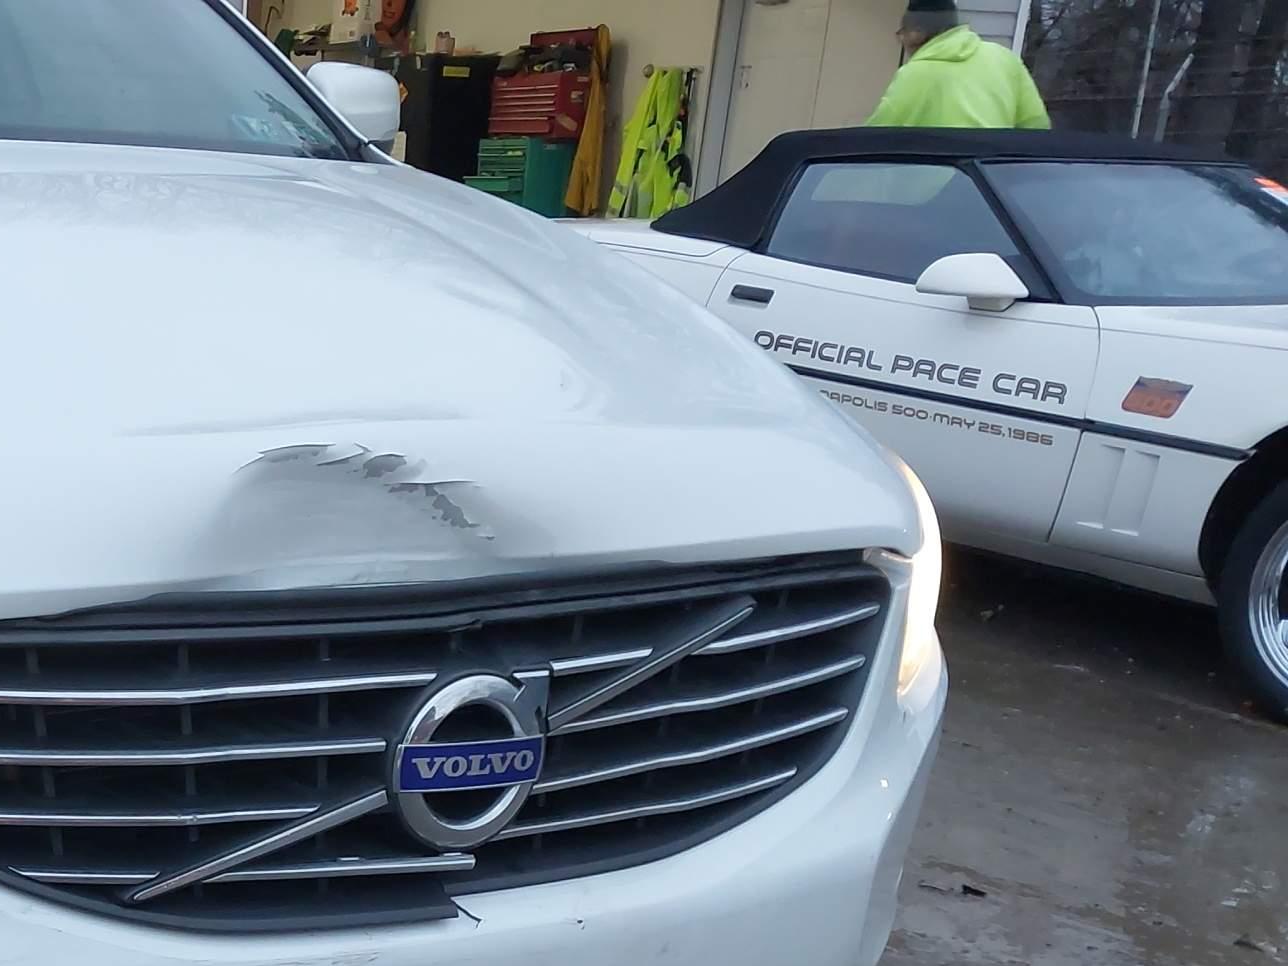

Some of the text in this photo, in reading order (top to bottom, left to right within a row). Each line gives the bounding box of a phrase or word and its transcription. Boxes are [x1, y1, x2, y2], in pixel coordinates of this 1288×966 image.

[754, 330, 1068, 405] OFFICIAL PACE CAR
[412, 750, 534, 779] VOLVO
